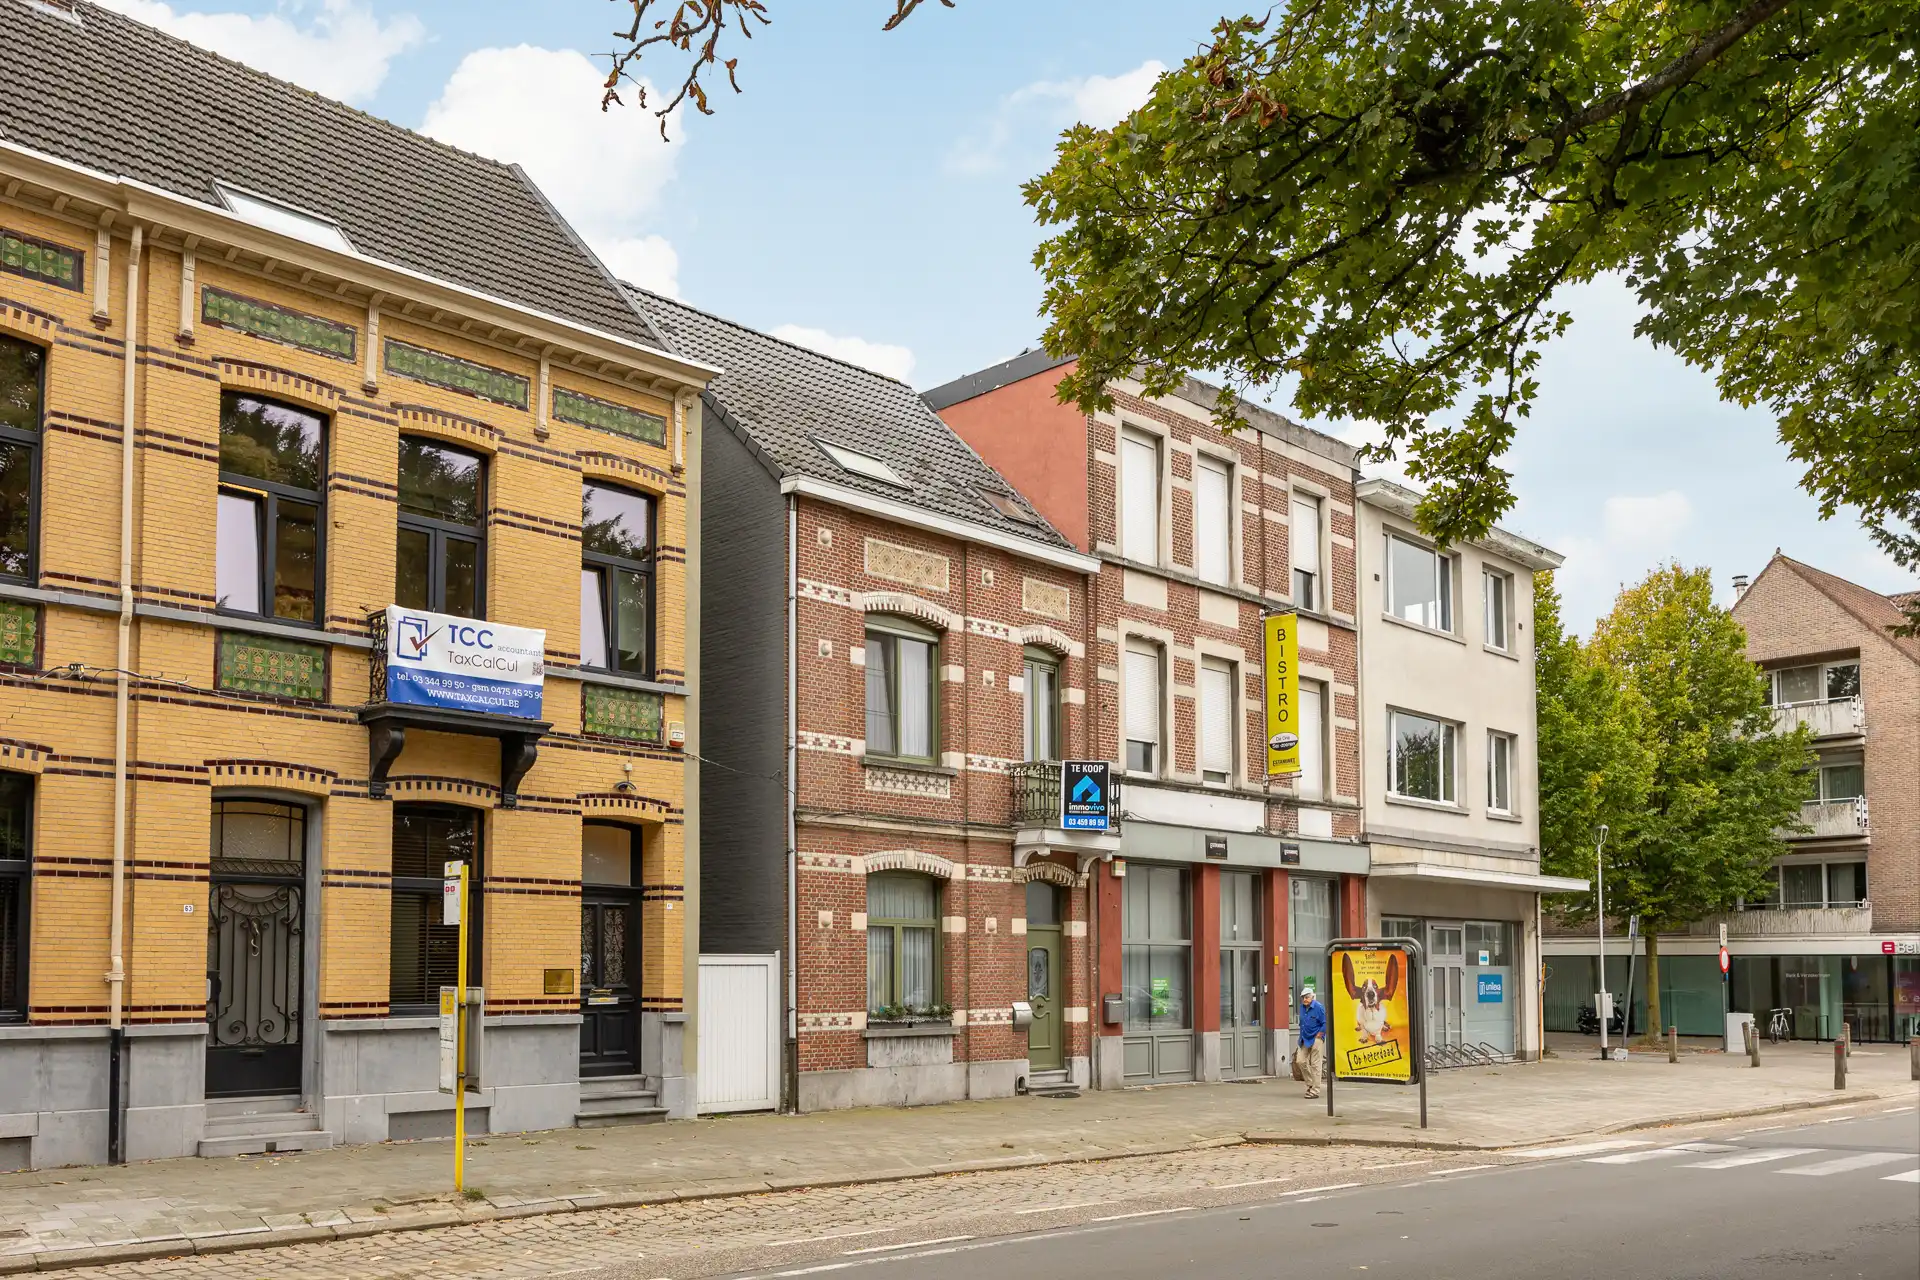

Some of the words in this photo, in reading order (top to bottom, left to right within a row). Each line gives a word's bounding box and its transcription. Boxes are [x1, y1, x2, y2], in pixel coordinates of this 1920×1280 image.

[448, 624, 494, 650] TCC
[447, 650, 518, 673] TaxCalCul
[396, 672, 411, 681] tel.
[412, 675, 423, 684] 03
[423, 676, 440, 687] 344
[442, 679, 453, 688] 99
[454, 680, 465, 689] 50
[471, 684, 489, 693] gsm
[490, 685, 511, 696] 0475
[511, 688, 523, 697] 45
[523, 689, 534, 698] 25
[1277, 628, 1289, 723] BISTRO
[426, 688, 520, 709] WWW.TAXCALCUL.BE
[1070, 764, 1081, 773] TE
[1082, 764, 1104, 773] KOOP
[1068, 802, 1105, 811] immovivo
[1068, 818, 1077, 826] 03
[1077, 818, 1088, 826] 459
[1088, 818, 1097, 826] 89
[1097, 819, 1105, 827] 59
[1353, 1053, 1362, 1066] Op
[1363, 1043, 1395, 1064] heterdaad
